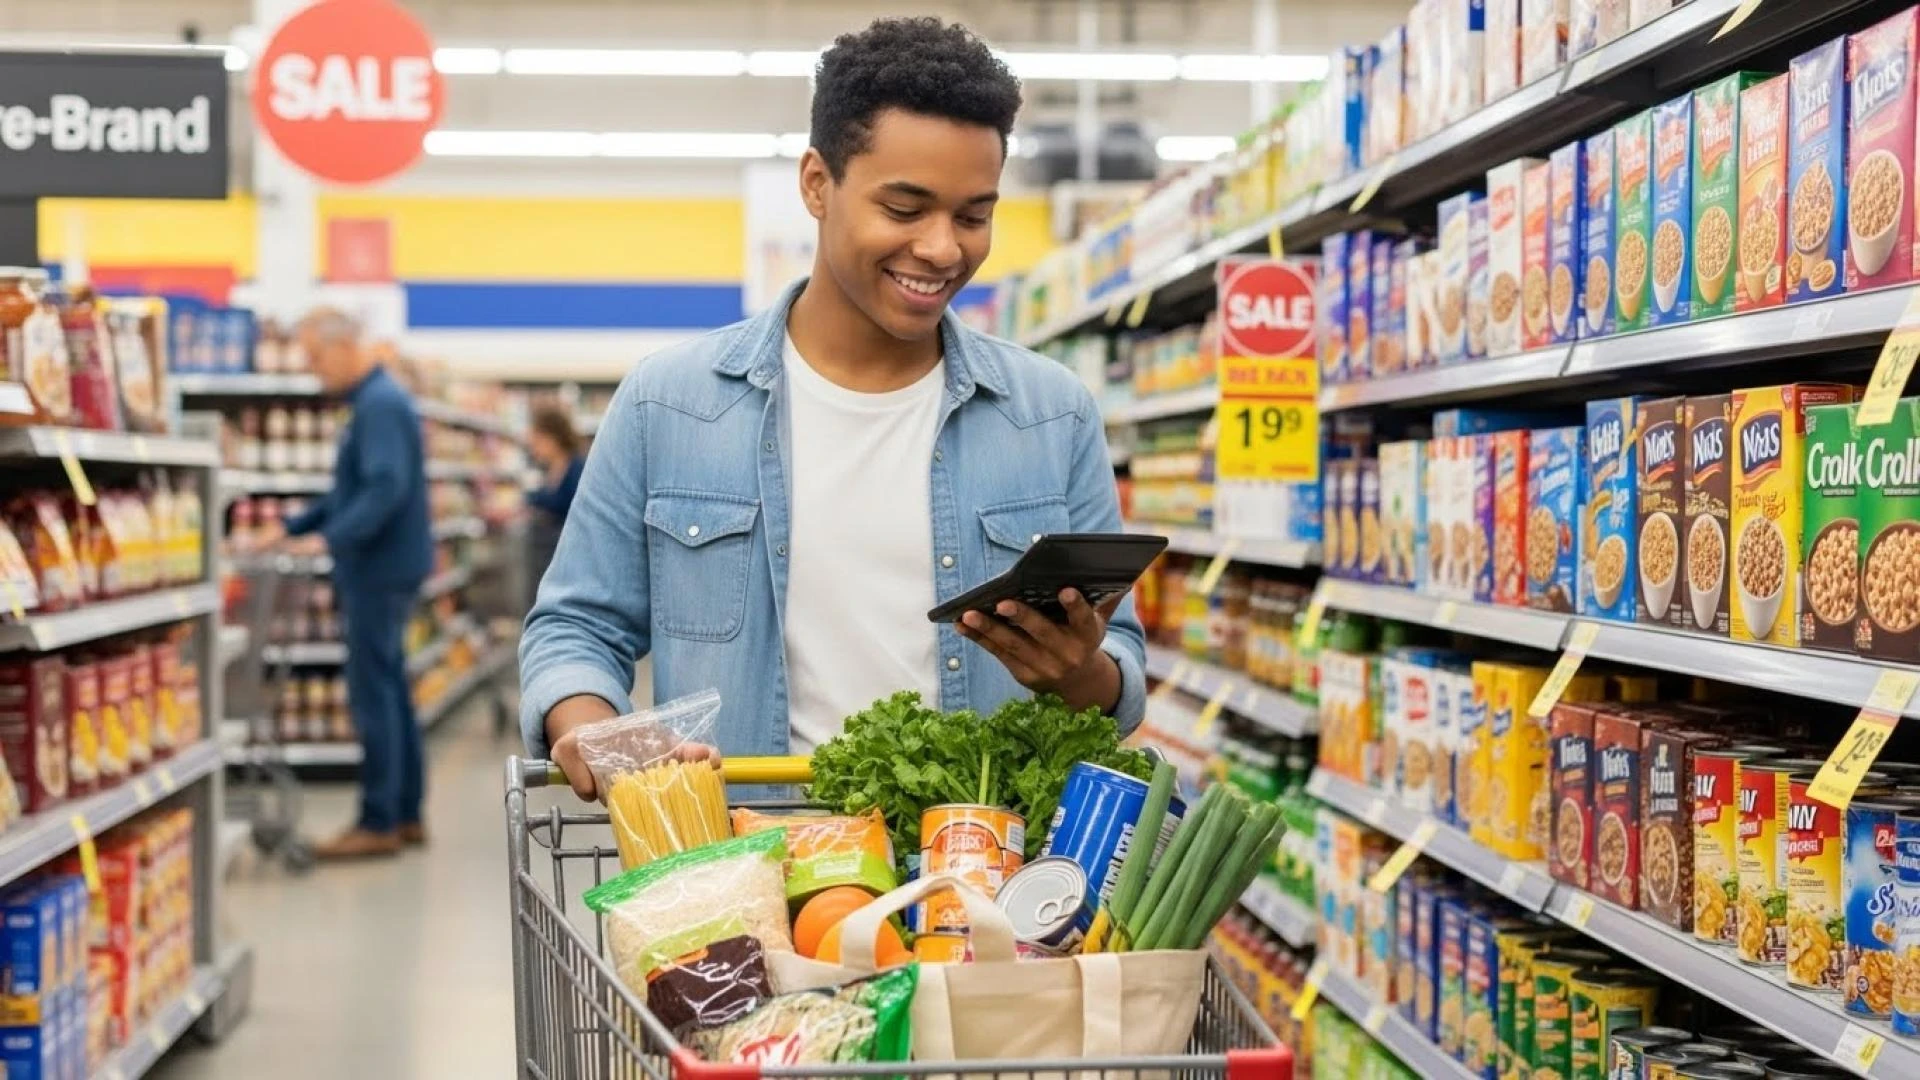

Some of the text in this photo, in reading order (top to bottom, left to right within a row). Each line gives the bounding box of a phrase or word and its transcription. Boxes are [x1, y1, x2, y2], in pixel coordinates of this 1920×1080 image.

[269, 53, 432, 121] SALE
[0, 95, 210, 153] e-Brand
[1227, 293, 1312, 330] SALE
